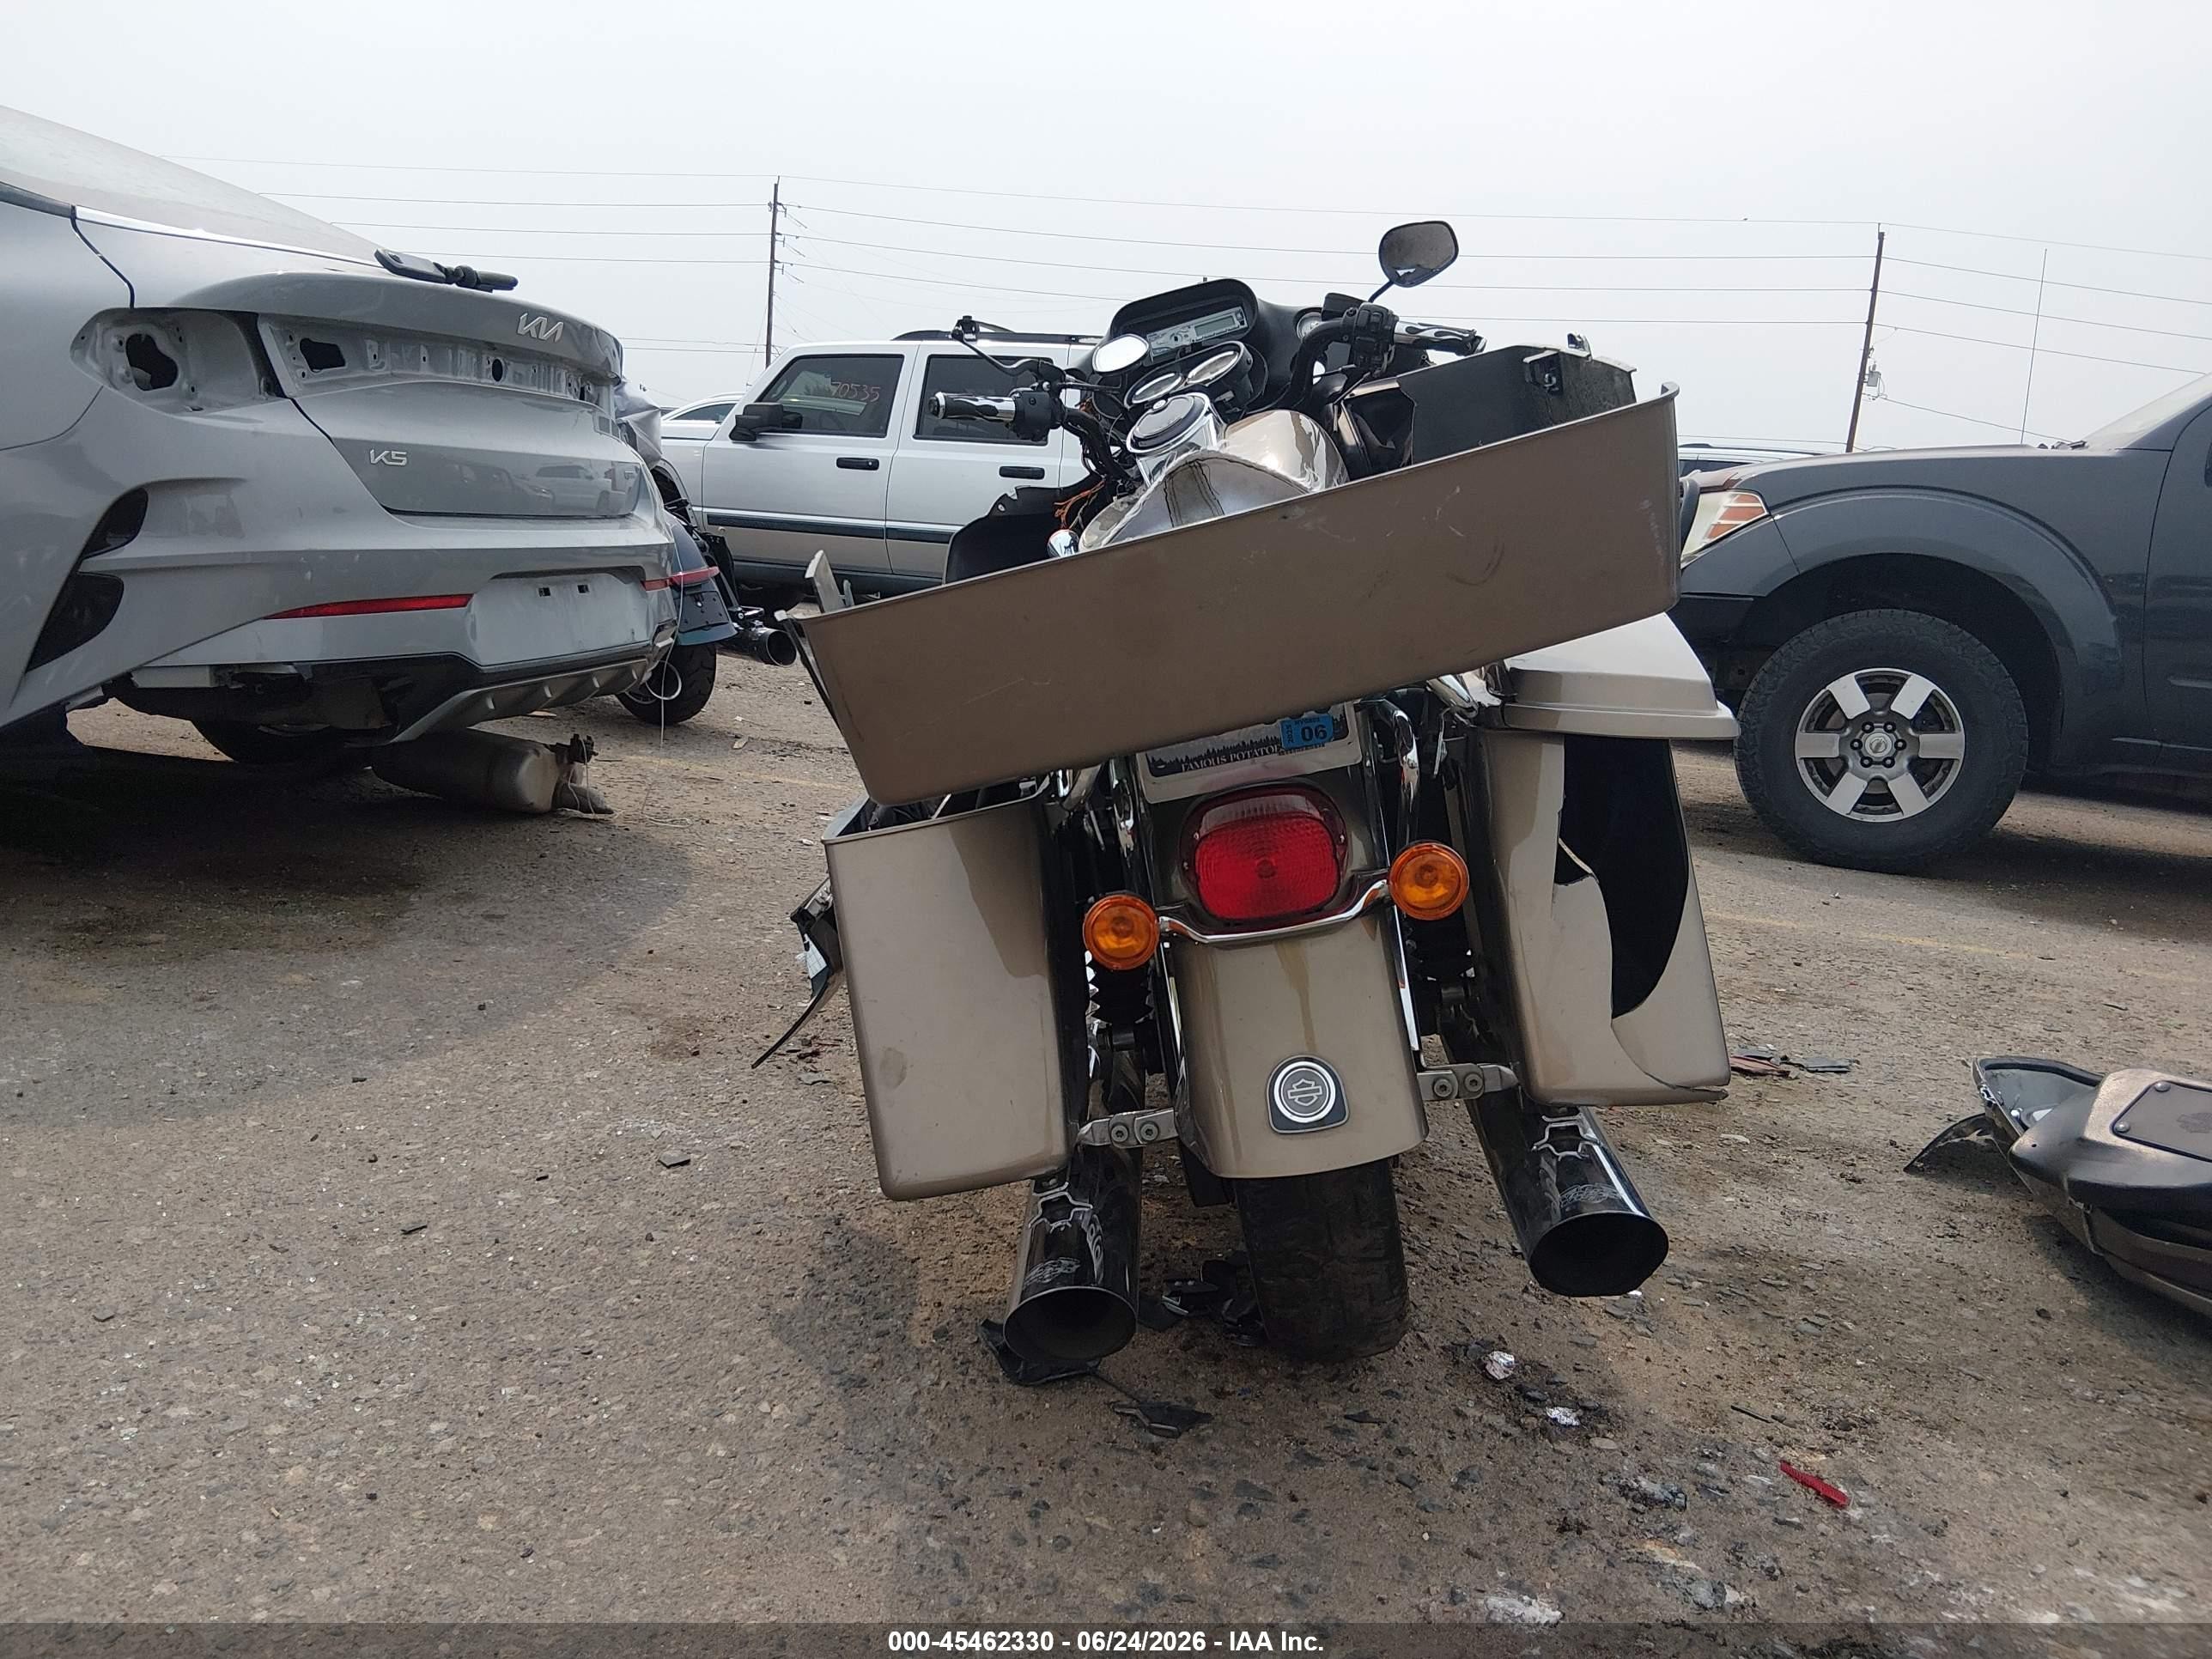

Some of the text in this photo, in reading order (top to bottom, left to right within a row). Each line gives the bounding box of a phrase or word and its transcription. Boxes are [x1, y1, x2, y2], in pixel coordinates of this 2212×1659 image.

[517, 313, 564, 343] KIA
[831, 381, 881, 403] 70535
[369, 448, 408, 466] K5
[1301, 724, 1328, 741] 06
[1182, 757, 1228, 773] FAMOUS
